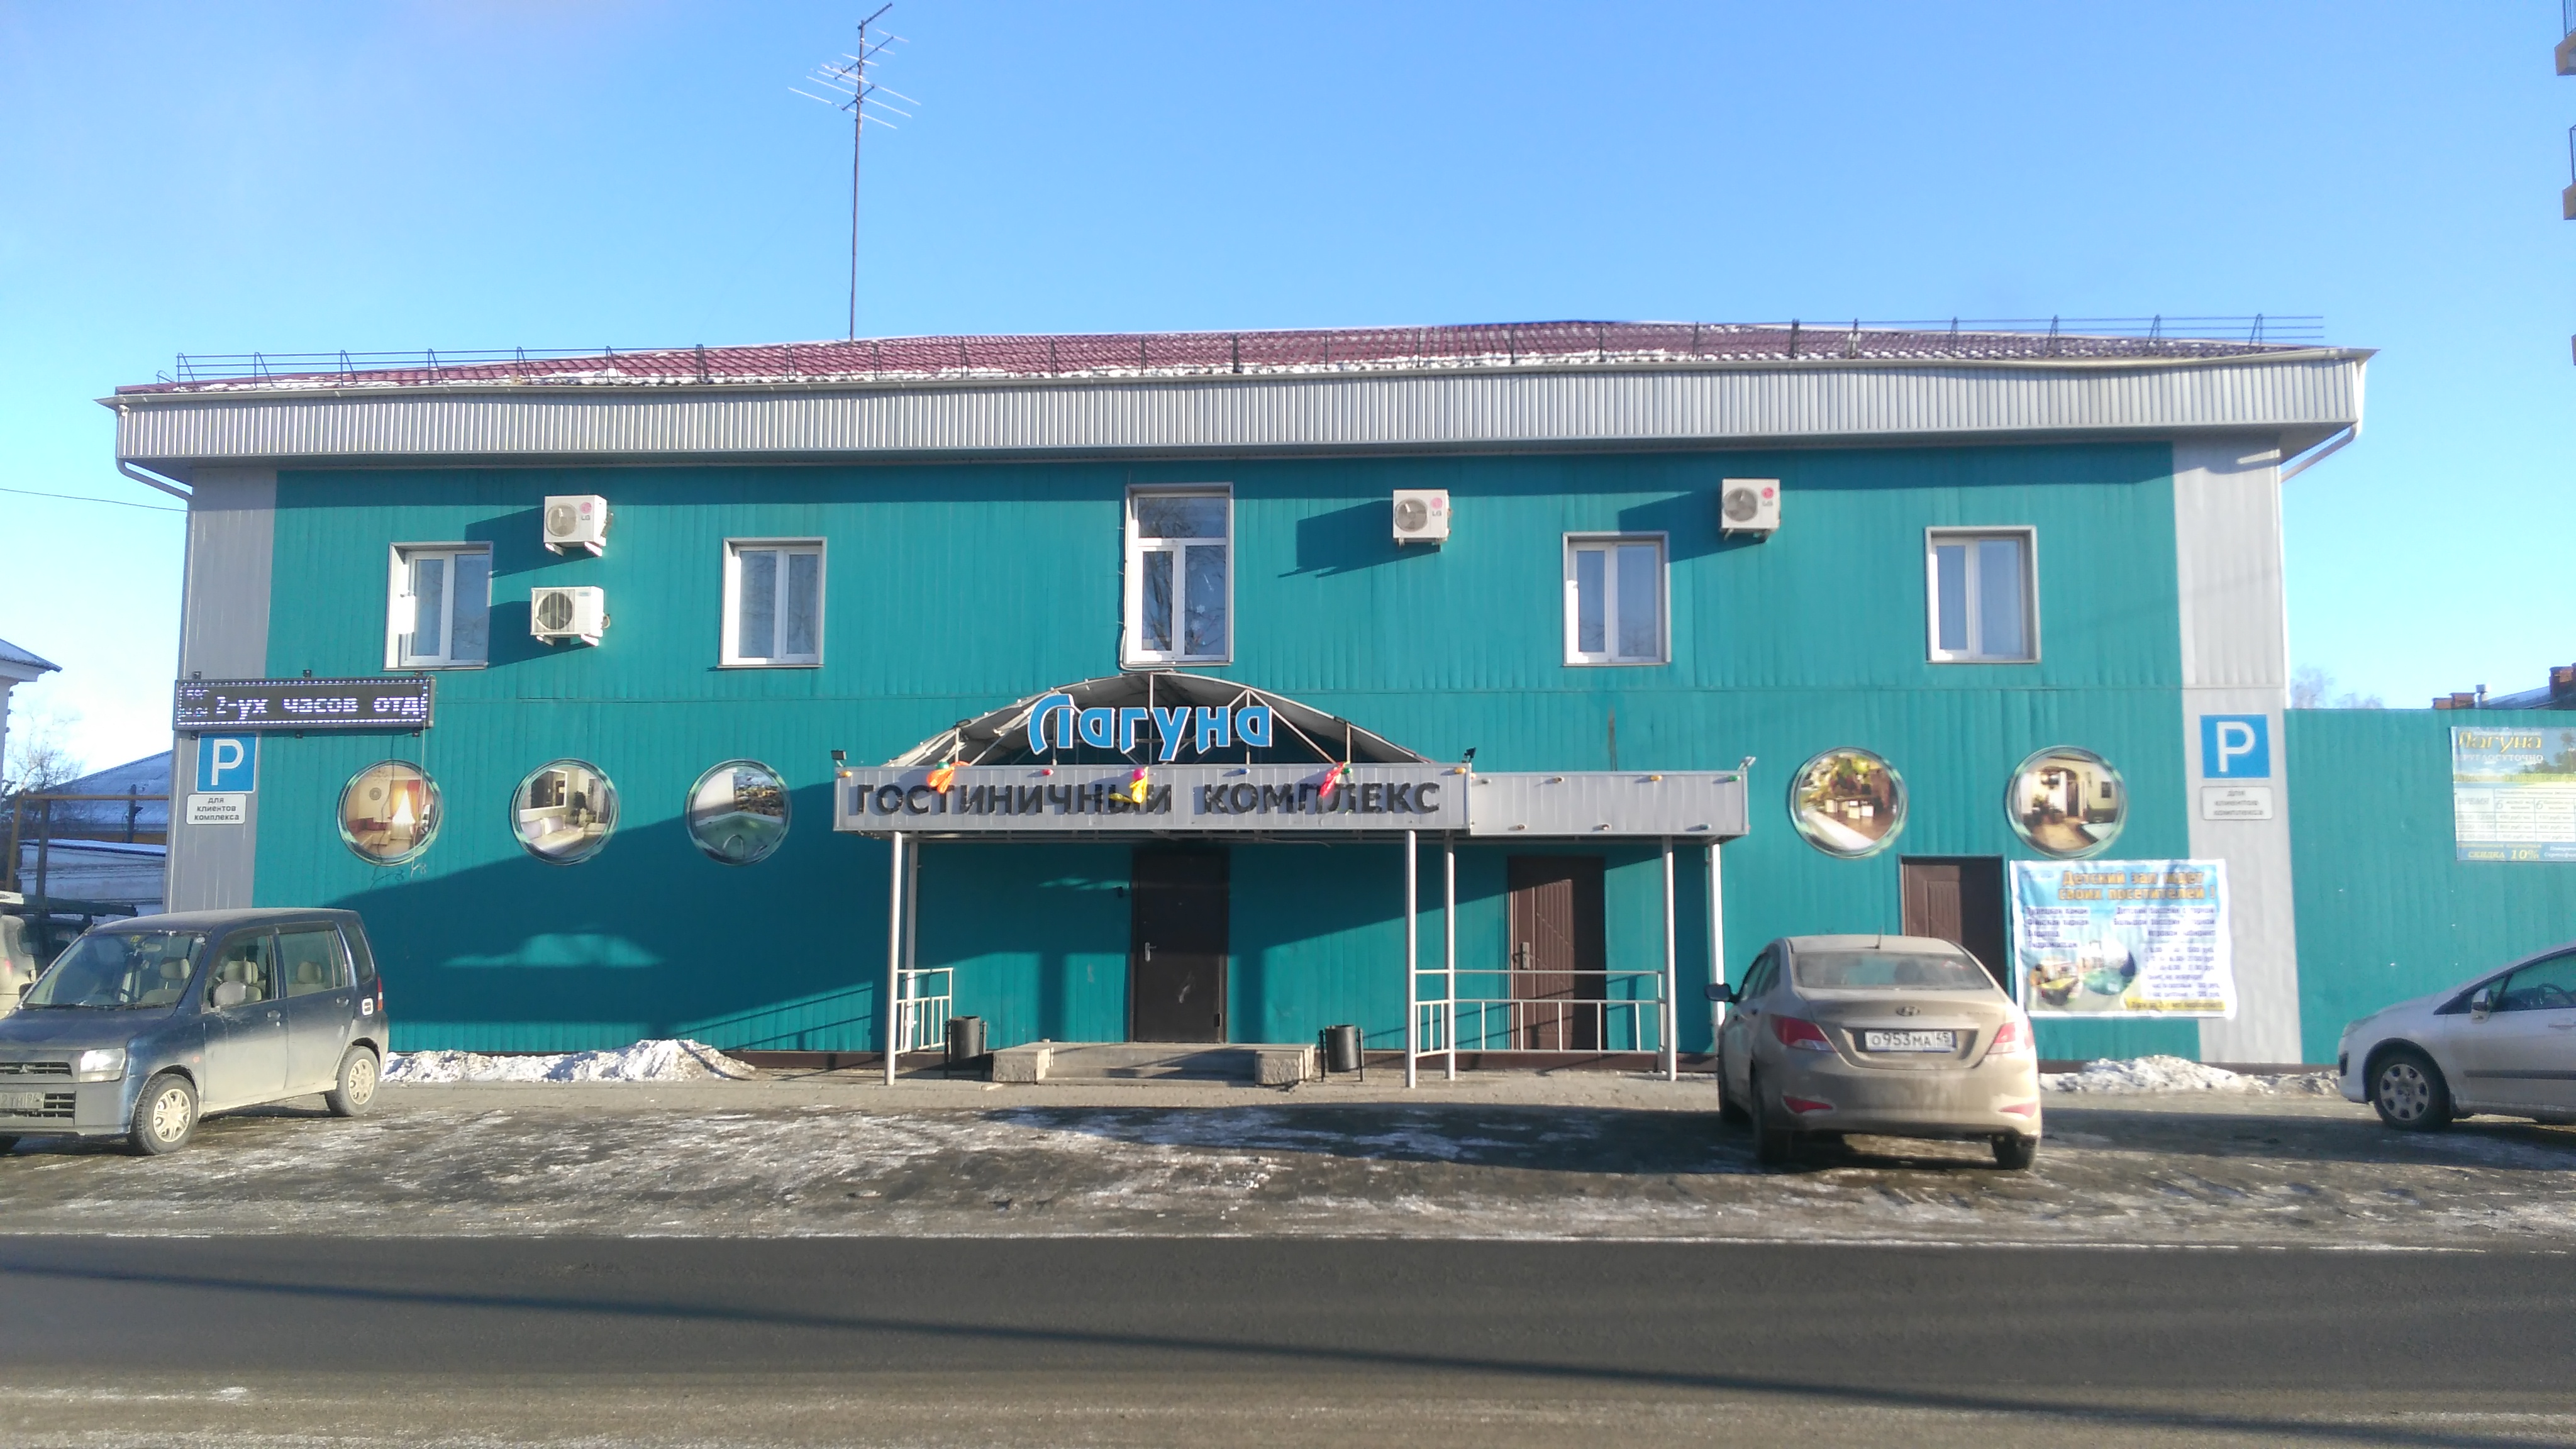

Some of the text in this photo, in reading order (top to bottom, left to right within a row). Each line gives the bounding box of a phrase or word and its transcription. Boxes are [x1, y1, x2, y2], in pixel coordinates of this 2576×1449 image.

[283, 697, 359, 713] часов
[1028, 694, 1272, 762] Лагуна
[2458, 731, 2542, 753] Лагуна
[1203, 782, 1440, 814] КОМПЛЕКС
[2511, 850, 2540, 860] 10%
